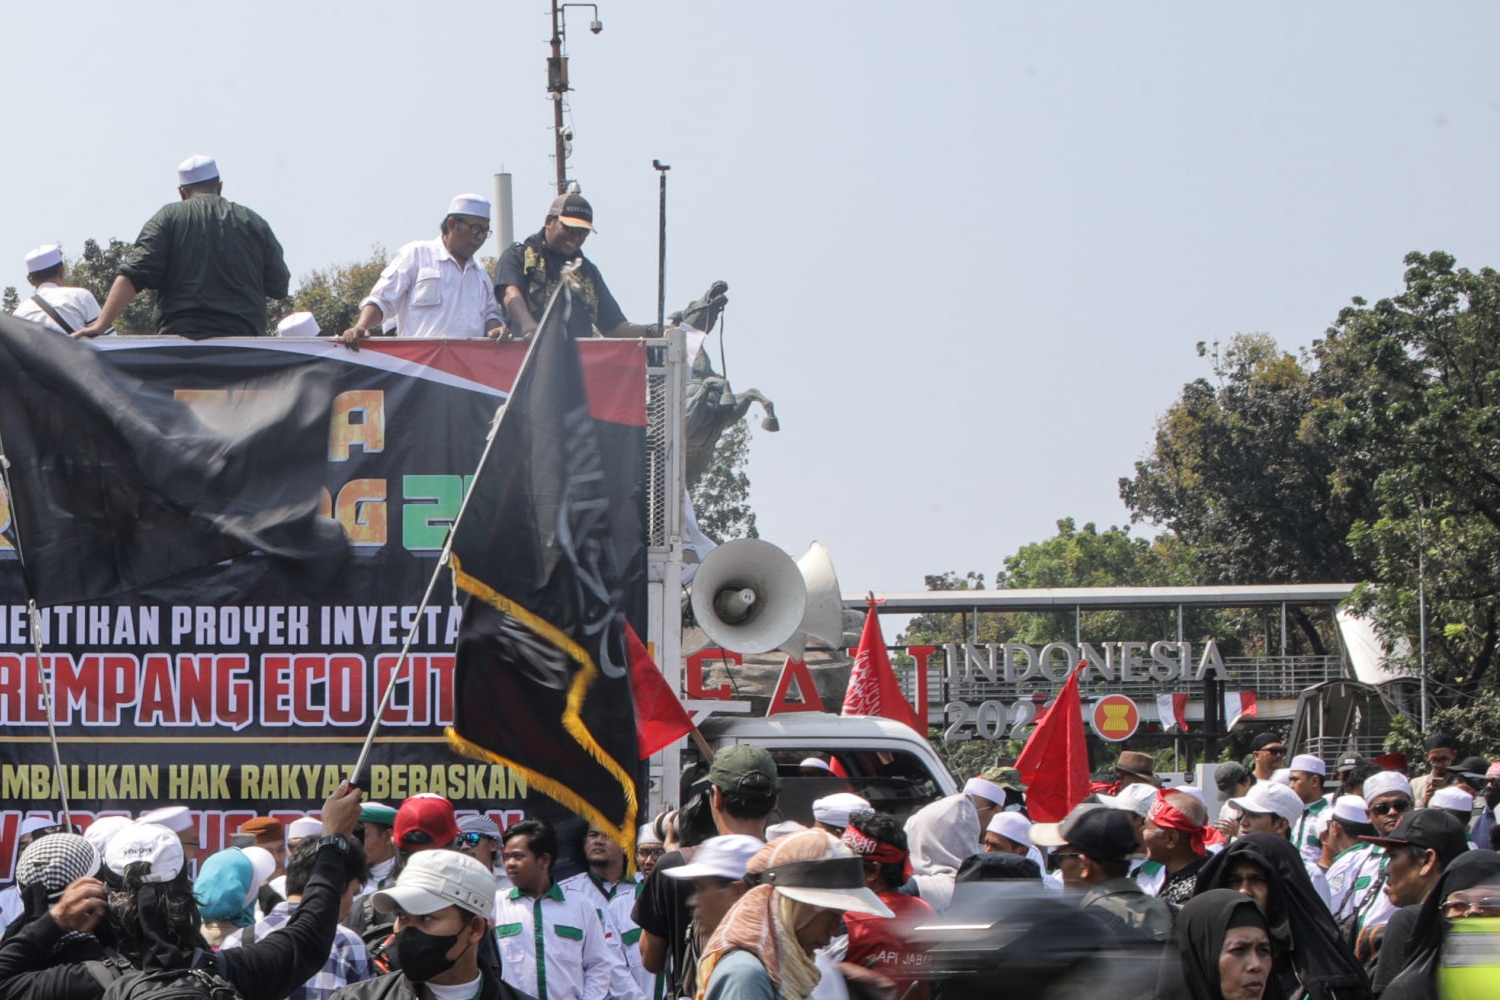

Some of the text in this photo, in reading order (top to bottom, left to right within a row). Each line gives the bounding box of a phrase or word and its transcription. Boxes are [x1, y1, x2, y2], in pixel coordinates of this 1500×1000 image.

[172, 606, 310, 646] PROYEK
[319, 605, 465, 646] INVESTA
[942, 638, 1232, 682] INDONESIA
[259, 652, 367, 728] ECO
[373, 652, 457, 728] CIT
[944, 699, 1052, 742] 202
[168, 764, 232, 800] HAK
[876, 951, 899, 965] API
